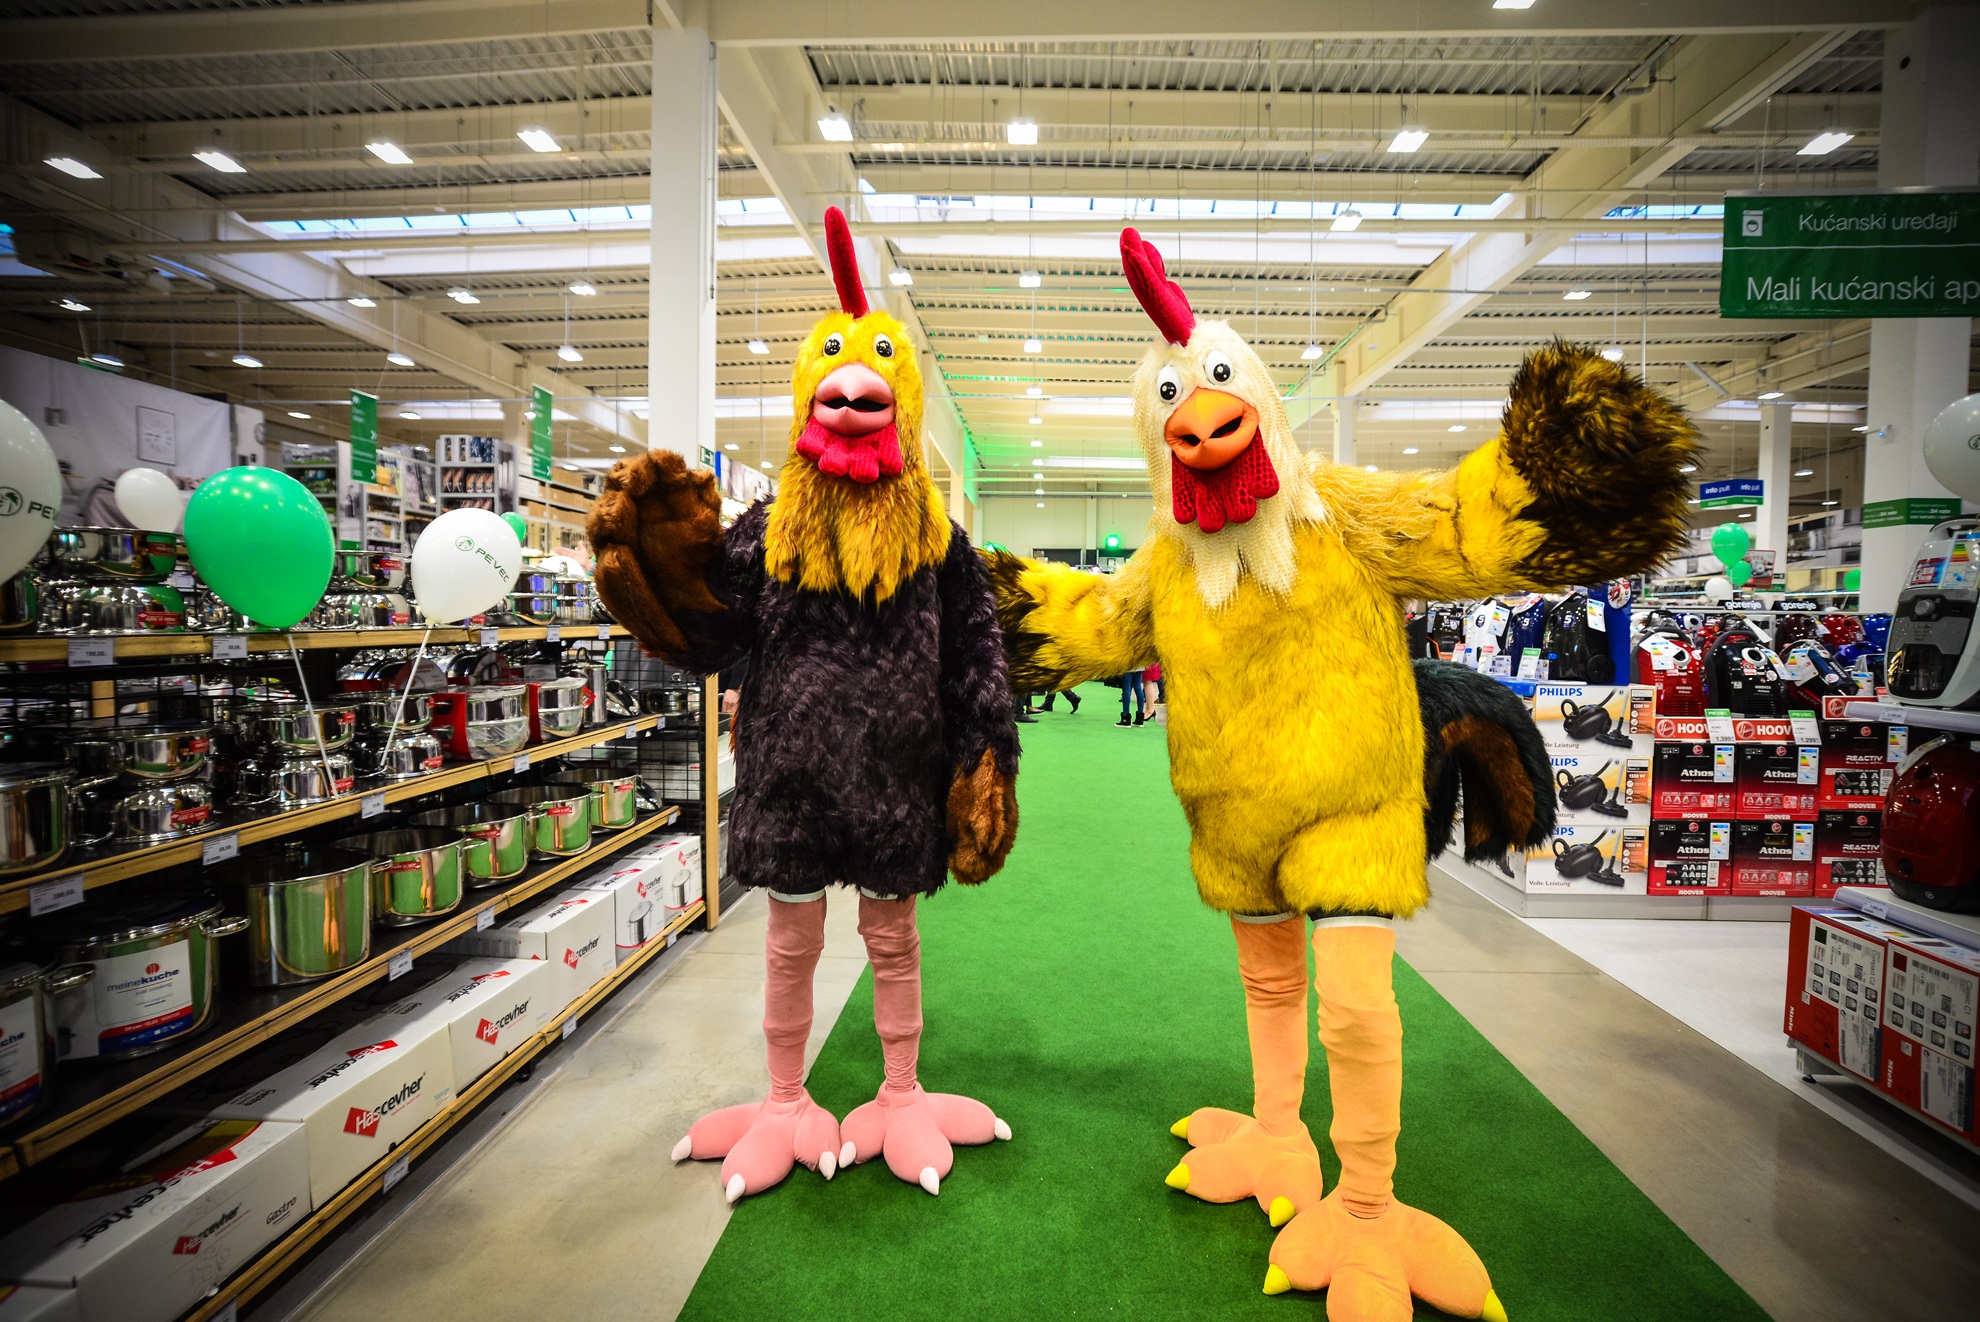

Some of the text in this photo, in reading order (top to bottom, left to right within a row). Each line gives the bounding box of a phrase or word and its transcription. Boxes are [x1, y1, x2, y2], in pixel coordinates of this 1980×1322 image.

[1799, 211, 1958, 233] Kućanski uređaji
[1746, 276, 1801, 301] Mali
[1811, 275, 1935, 301] kućanski
[475, 547, 510, 583] PEVEC
[1725, 600, 1762, 610] gorenje
[1781, 601, 1817, 610] gorenje
[1540, 687, 1583, 697] PHILIPS
[1677, 723, 1709, 734] HOOV
[1756, 724, 1791, 736] HOOV
[1551, 758, 1579, 767] ILIPS
[1681, 769, 1714, 777] Athos
[1763, 770, 1797, 778] Athos
[1677, 846, 1710, 854] Athos
[1759, 847, 1792, 855] Athos
[482, 1000, 529, 1040] Hascevher
[355, 1076, 424, 1134] Hascevher
[78, 1159, 215, 1244] Hascevher
[266, 1196, 297, 1225] Gastro
[182, 1205, 241, 1254] Hascevher
